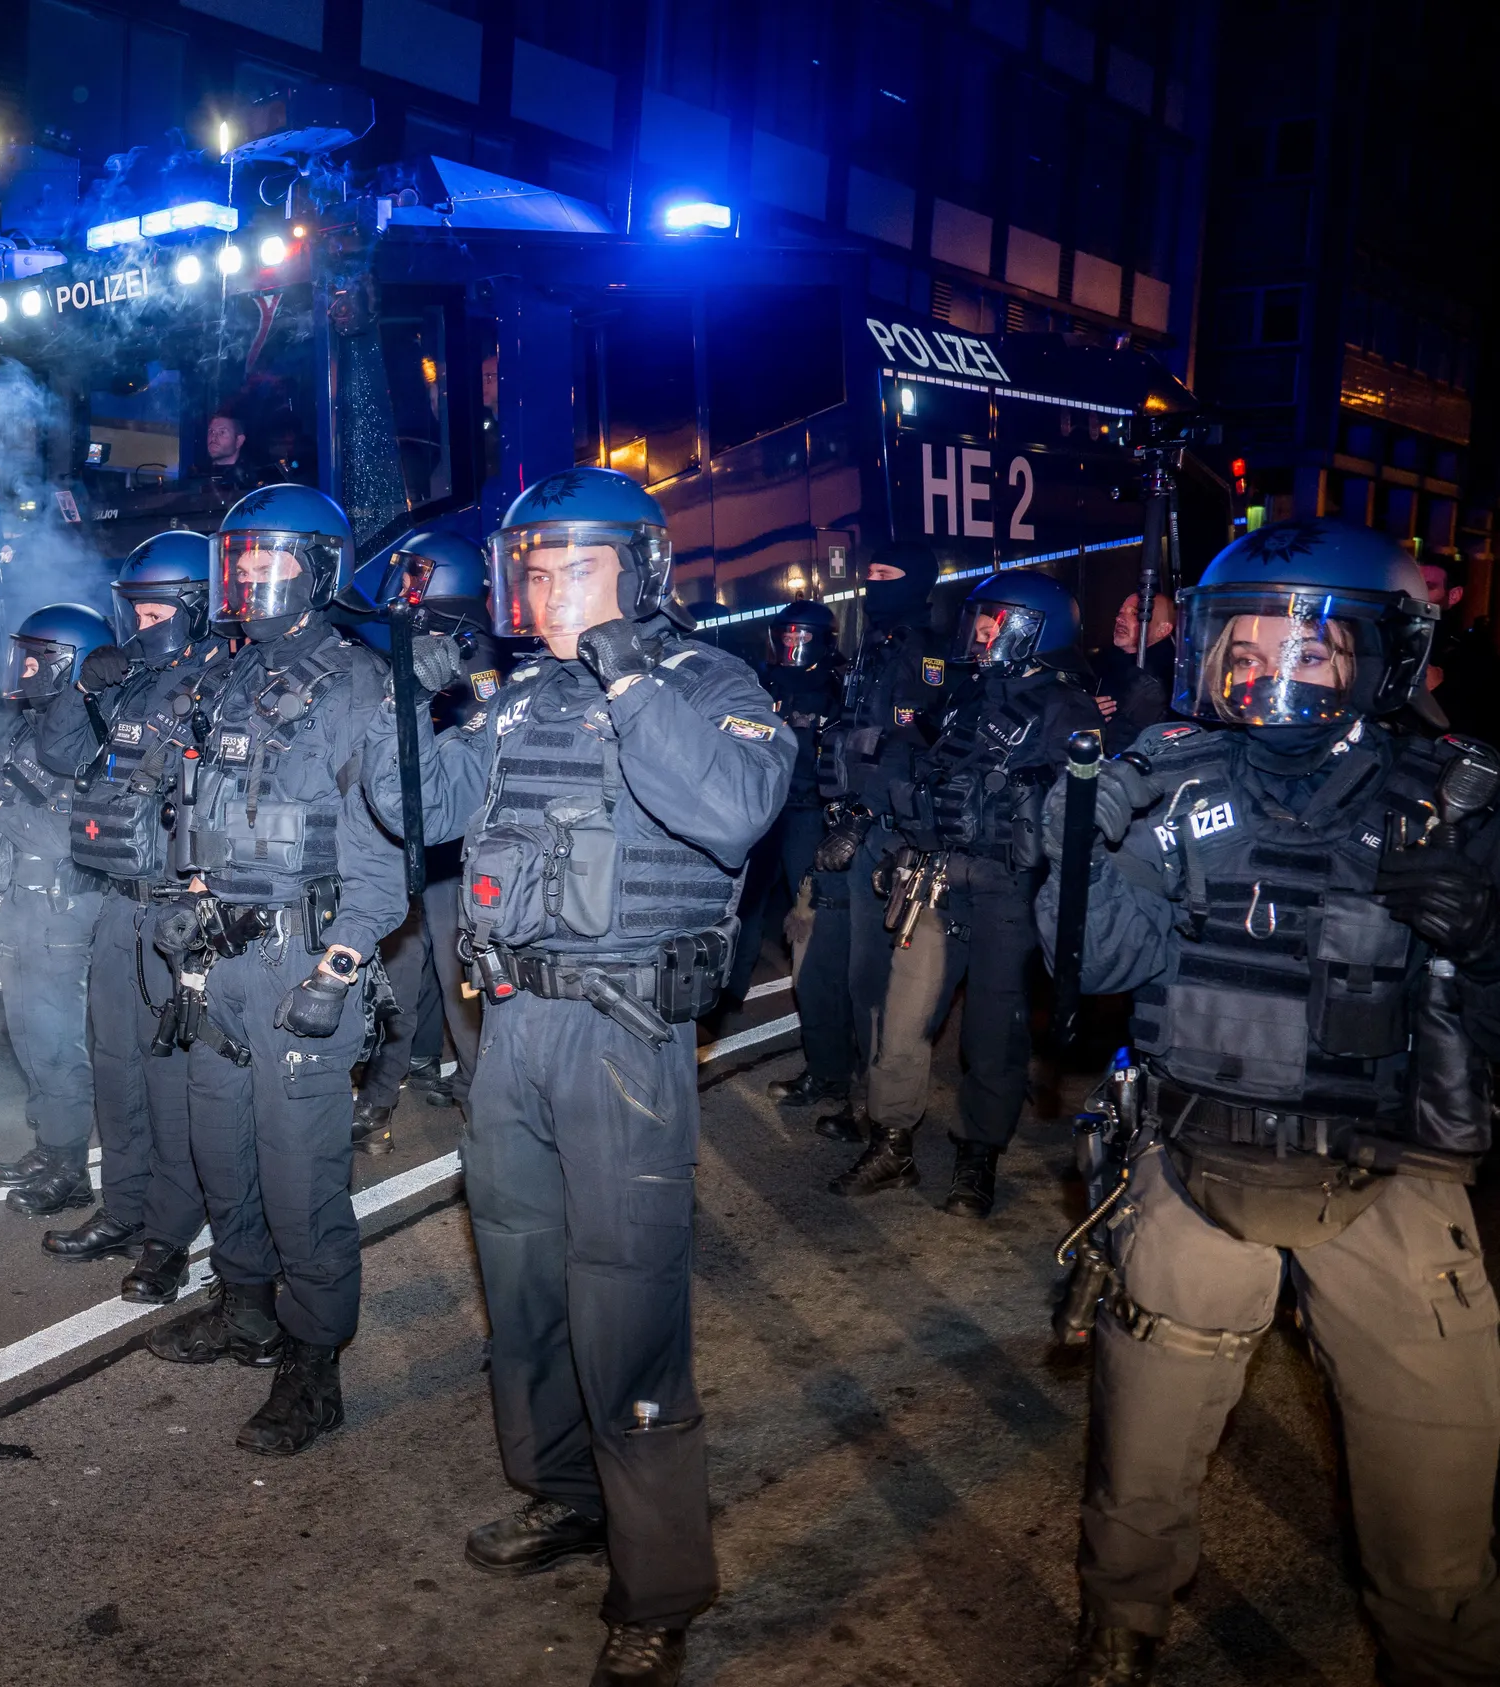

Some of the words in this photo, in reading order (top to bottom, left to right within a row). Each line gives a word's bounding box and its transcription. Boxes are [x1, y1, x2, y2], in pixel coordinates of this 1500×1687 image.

[56, 268, 149, 313] POLIZEI
[866, 318, 1011, 382] POLIZEI
[922, 443, 994, 538] HE
[1009, 456, 1035, 540] 2
[118, 723, 131, 732] EE33
[222, 736, 236, 745] EE33
[1153, 802, 1235, 851] PIZEI
[1361, 833, 1382, 848] HE
